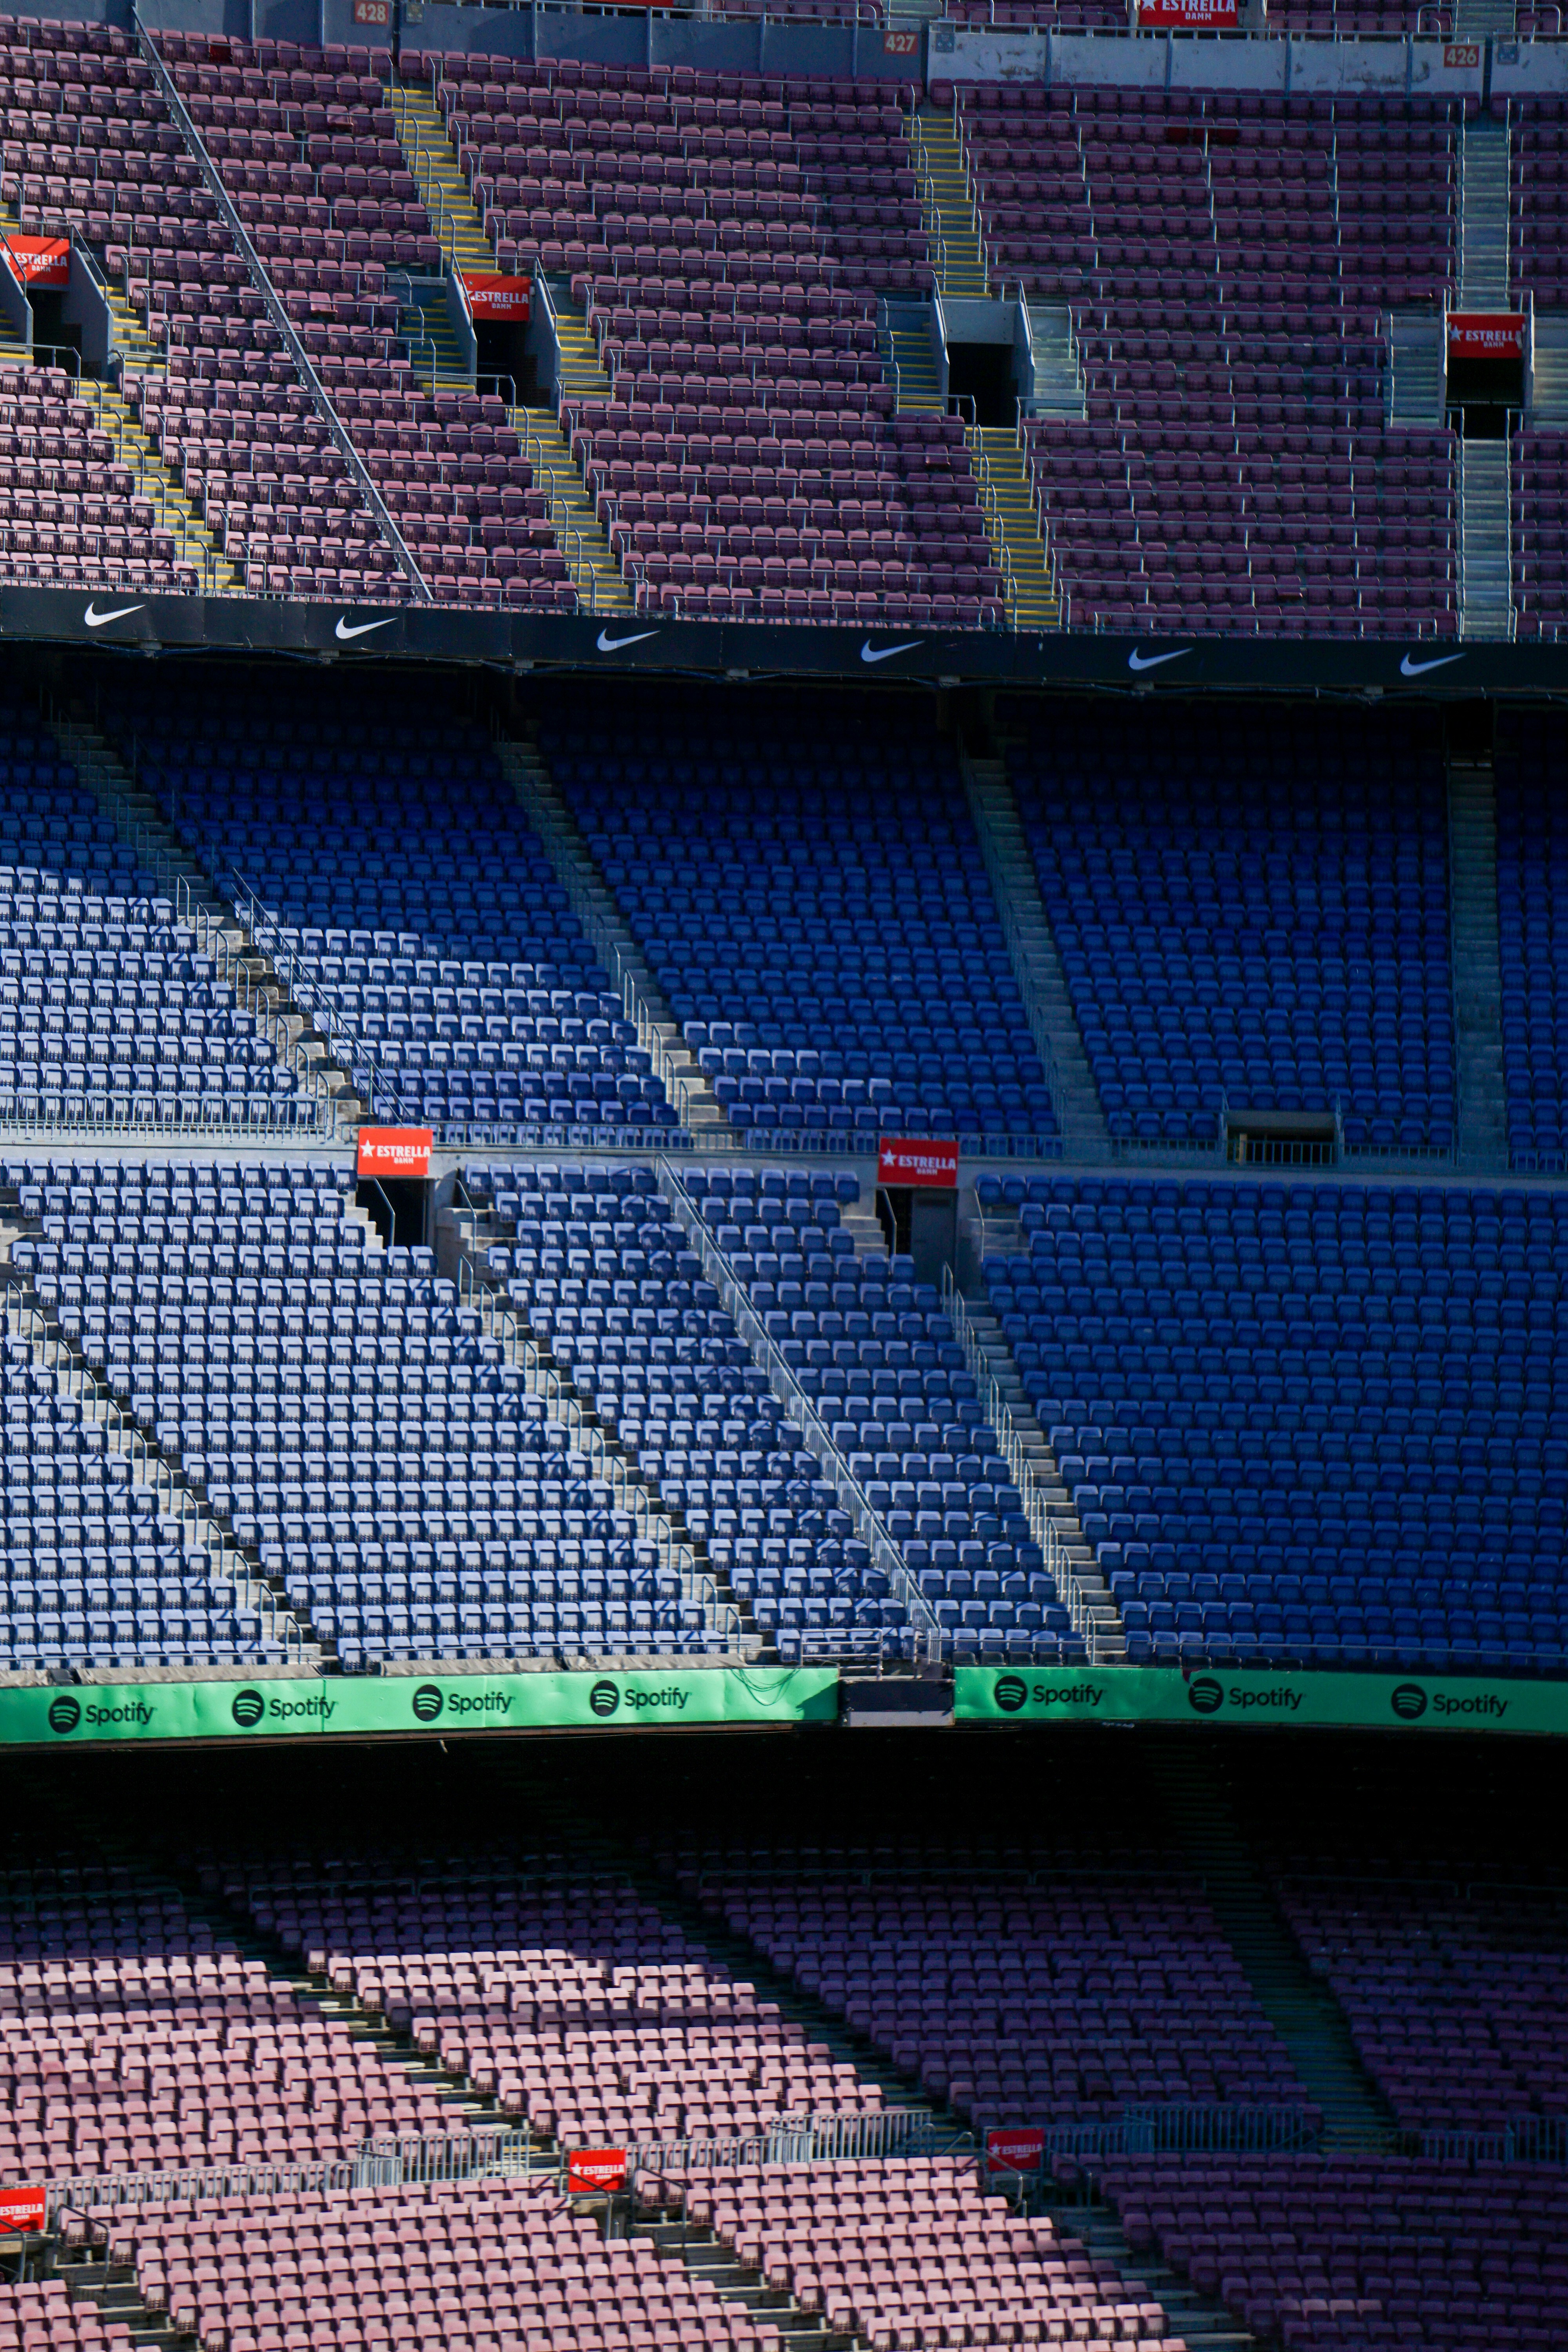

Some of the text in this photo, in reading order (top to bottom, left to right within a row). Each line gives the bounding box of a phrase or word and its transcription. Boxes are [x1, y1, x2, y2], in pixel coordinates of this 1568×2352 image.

[357, 3, 386, 22] 428
[1162, 0, 1236, 12] ESTRELLA
[886, 34, 916, 51] 427
[1446, 48, 1477, 65] 426
[15, 252, 67, 267] ESTRELLA
[475, 291, 529, 304] ESTRELLA
[377, 1145, 431, 1158] ESTRELLA
[898, 1155, 956, 1169] ESTRELLA
[448, 1691, 514, 1715] Spotify
[624, 1687, 690, 1710] Spotify
[1033, 1684, 1103, 1706] Spotify
[1229, 1687, 1303, 1710] Spotify
[85, 1702, 155, 1726] Spotify
[269, 1696, 337, 1720] Spotify
[1433, 1694, 1508, 1717] Spotify
